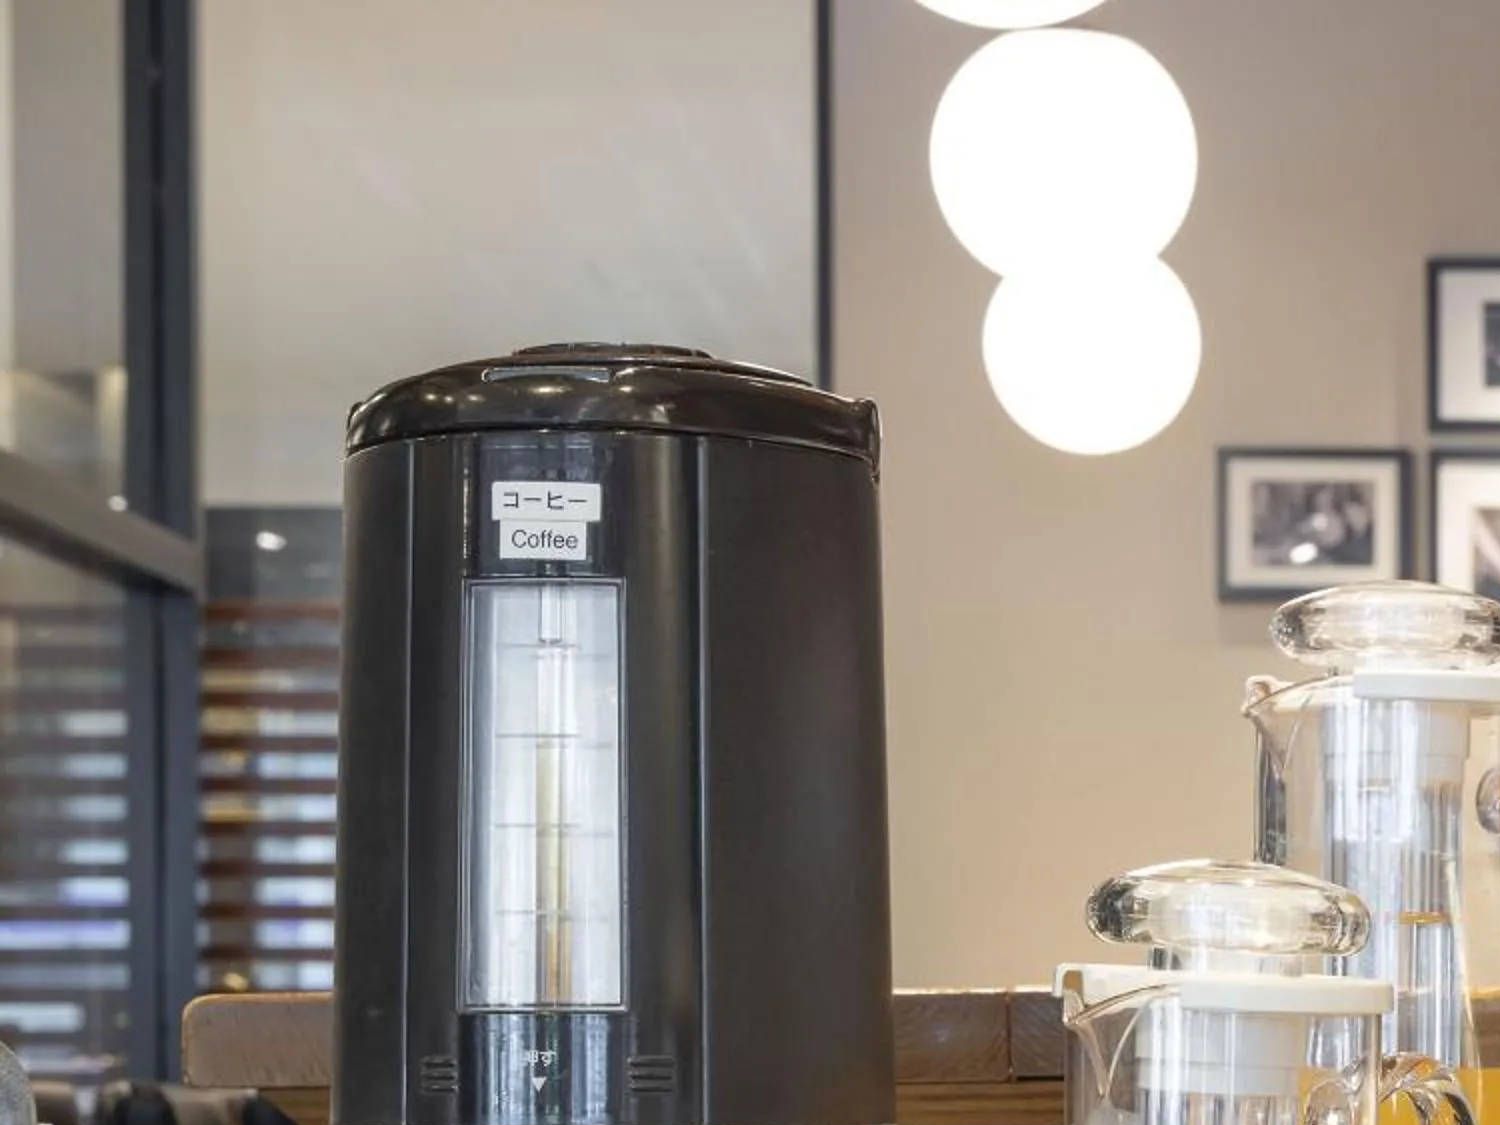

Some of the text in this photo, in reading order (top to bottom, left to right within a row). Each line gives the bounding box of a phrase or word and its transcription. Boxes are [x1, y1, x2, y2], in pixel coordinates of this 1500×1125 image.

[503, 491, 588, 510] コーヒー
[511, 529, 579, 549] Coffee
